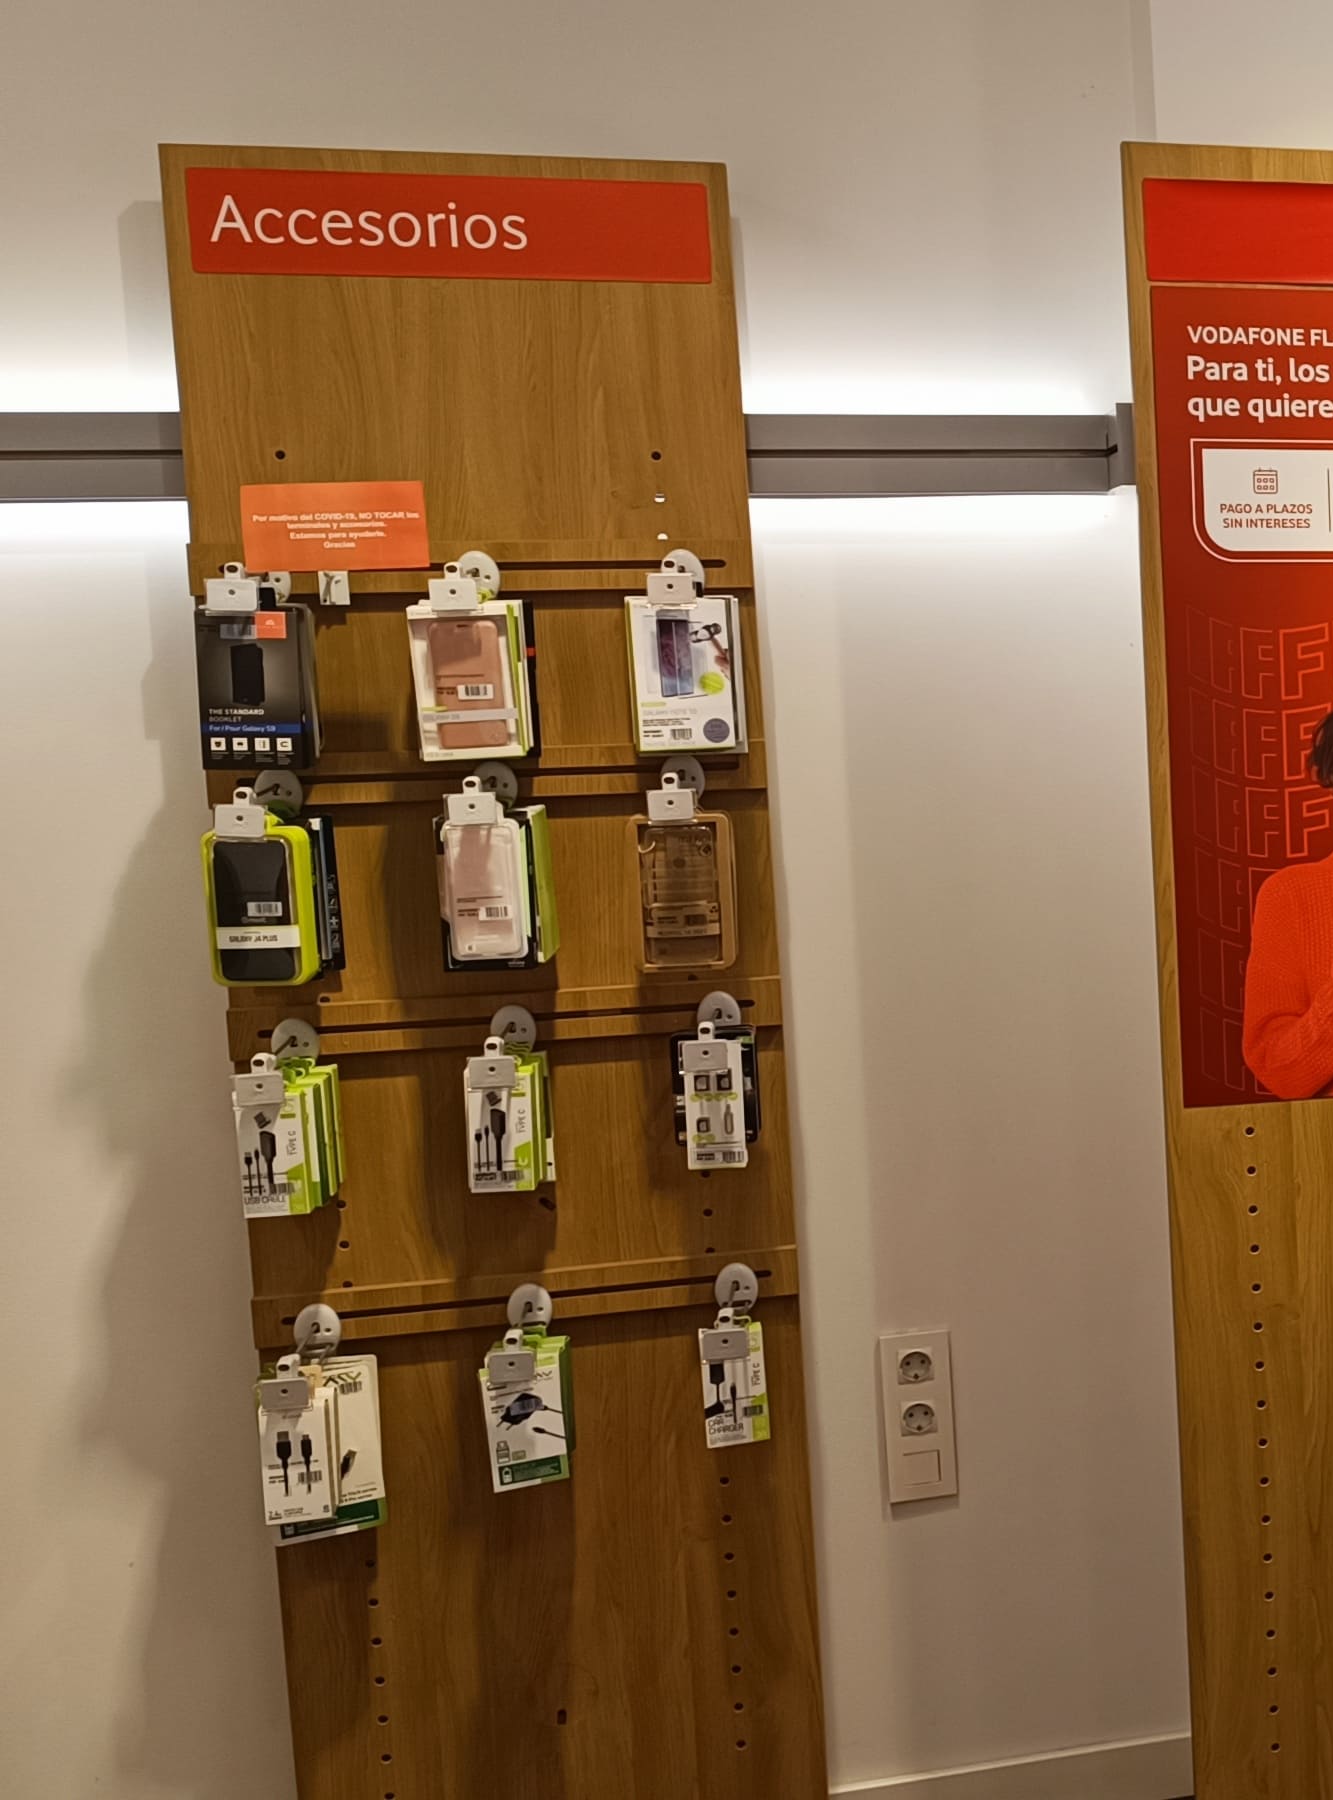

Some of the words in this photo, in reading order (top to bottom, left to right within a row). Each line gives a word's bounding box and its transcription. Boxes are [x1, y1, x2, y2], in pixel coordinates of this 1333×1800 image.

[210, 195, 528, 250] Accesorios
[1187, 325, 1306, 347] VODAFONE
[1186, 355, 1249, 381] Para
[1254, 358, 1282, 386] ti,
[1289, 358, 1330, 383] los
[1187, 396, 1241, 422] que
[359, 511, 372, 520] NO
[374, 511, 405, 519] TOCAR
[1220, 503, 1253, 514] PAGO
[1254, 504, 1264, 514] A
[1266, 504, 1313, 515] PLAZOS
[1223, 517, 1243, 528] SIN
[1246, 518, 1311, 529] INTERESES
